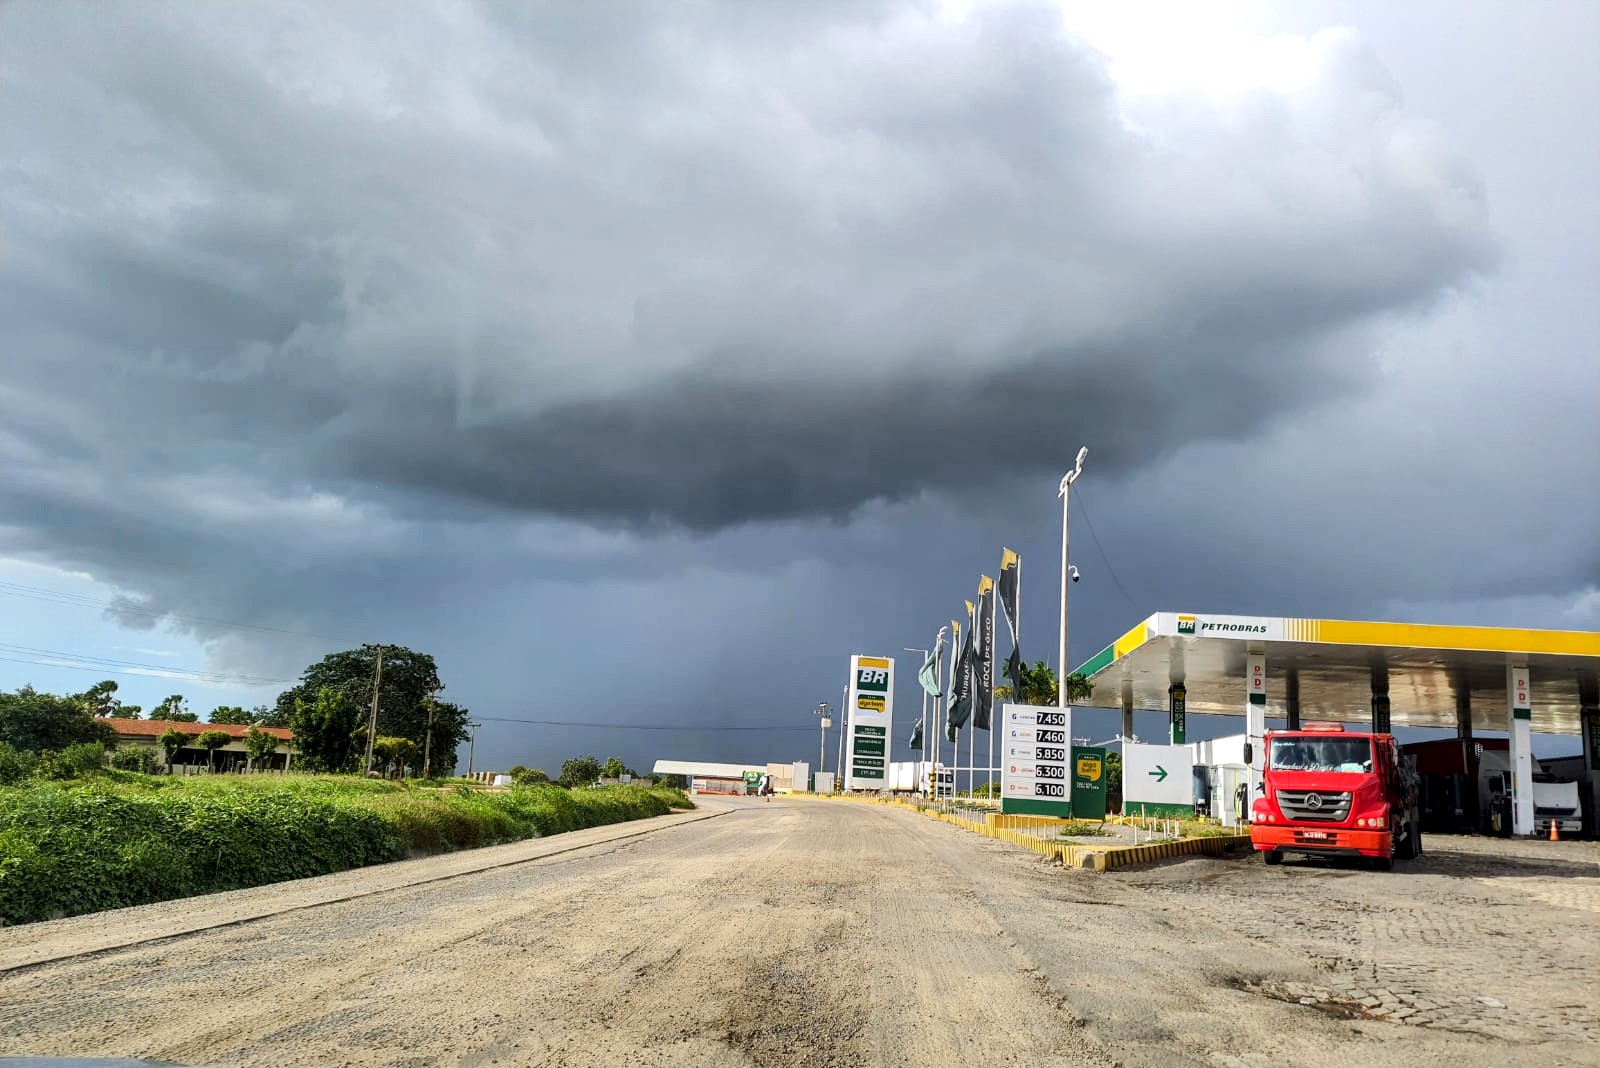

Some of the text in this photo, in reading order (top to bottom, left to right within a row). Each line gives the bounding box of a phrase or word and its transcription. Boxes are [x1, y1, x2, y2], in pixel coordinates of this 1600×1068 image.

[1179, 621, 1267, 633] BR PETROBRAS
[860, 670, 886, 684] BR
[1254, 678, 1261, 687] D
